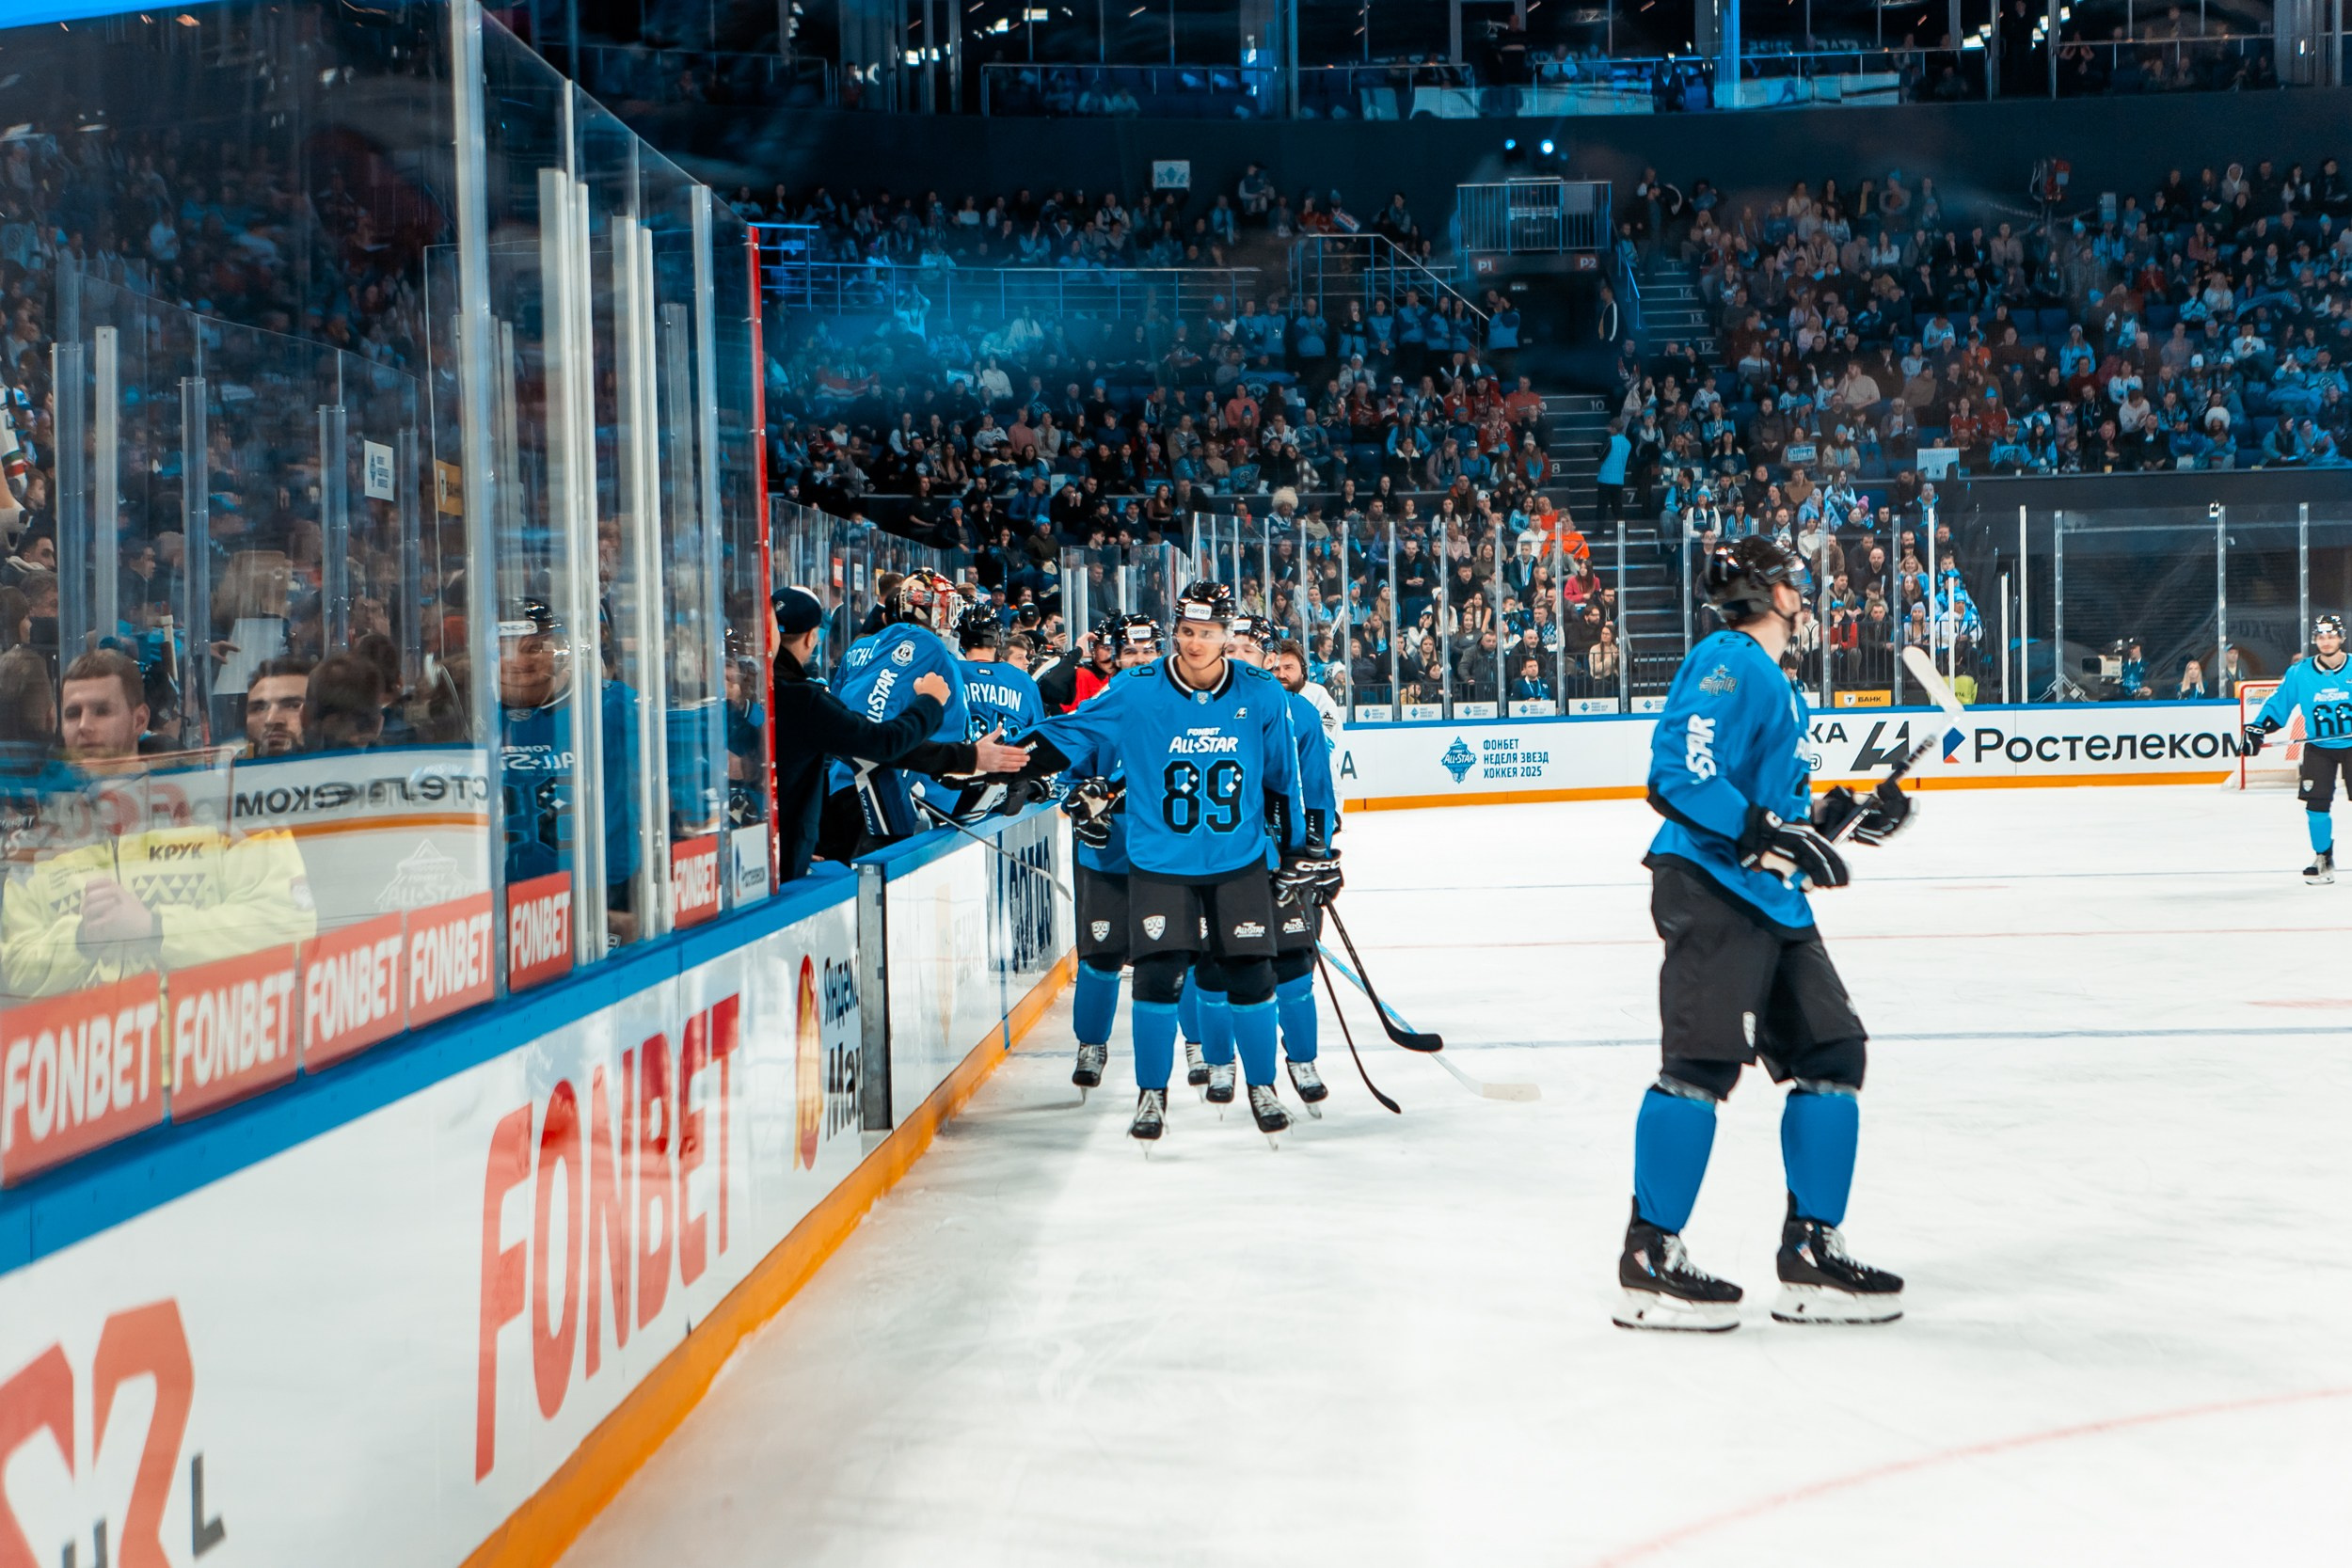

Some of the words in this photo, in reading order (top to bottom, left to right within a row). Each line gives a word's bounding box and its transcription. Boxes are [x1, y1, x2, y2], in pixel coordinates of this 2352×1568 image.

[1580, 257, 1597, 269] P2
[1690, 313, 1703, 325] 13
[1701, 341, 1713, 353] 12
[1590, 400, 1604, 411] 10
[1551, 463, 1561, 474] 8
[1627, 492, 1635, 503] 7
[1483, 738, 1519, 751] ФОНБЕТ
[1484, 752, 1518, 766] НЕДЕЛЯ
[1520, 752, 1549, 765] ЗВЕЗД
[1483, 767, 1518, 779] ХОККЕЯ
[1520, 766, 1542, 777] 2025
[1162, 758, 1247, 836] 89
[510, 890, 572, 973] FONBET
[409, 911, 493, 1008] FONBET
[304, 934, 404, 1048] FONBET
[173, 972, 295, 1096] FONBET
[2, 1002, 158, 1149] FONBET
[474, 991, 740, 1485] FONBET
